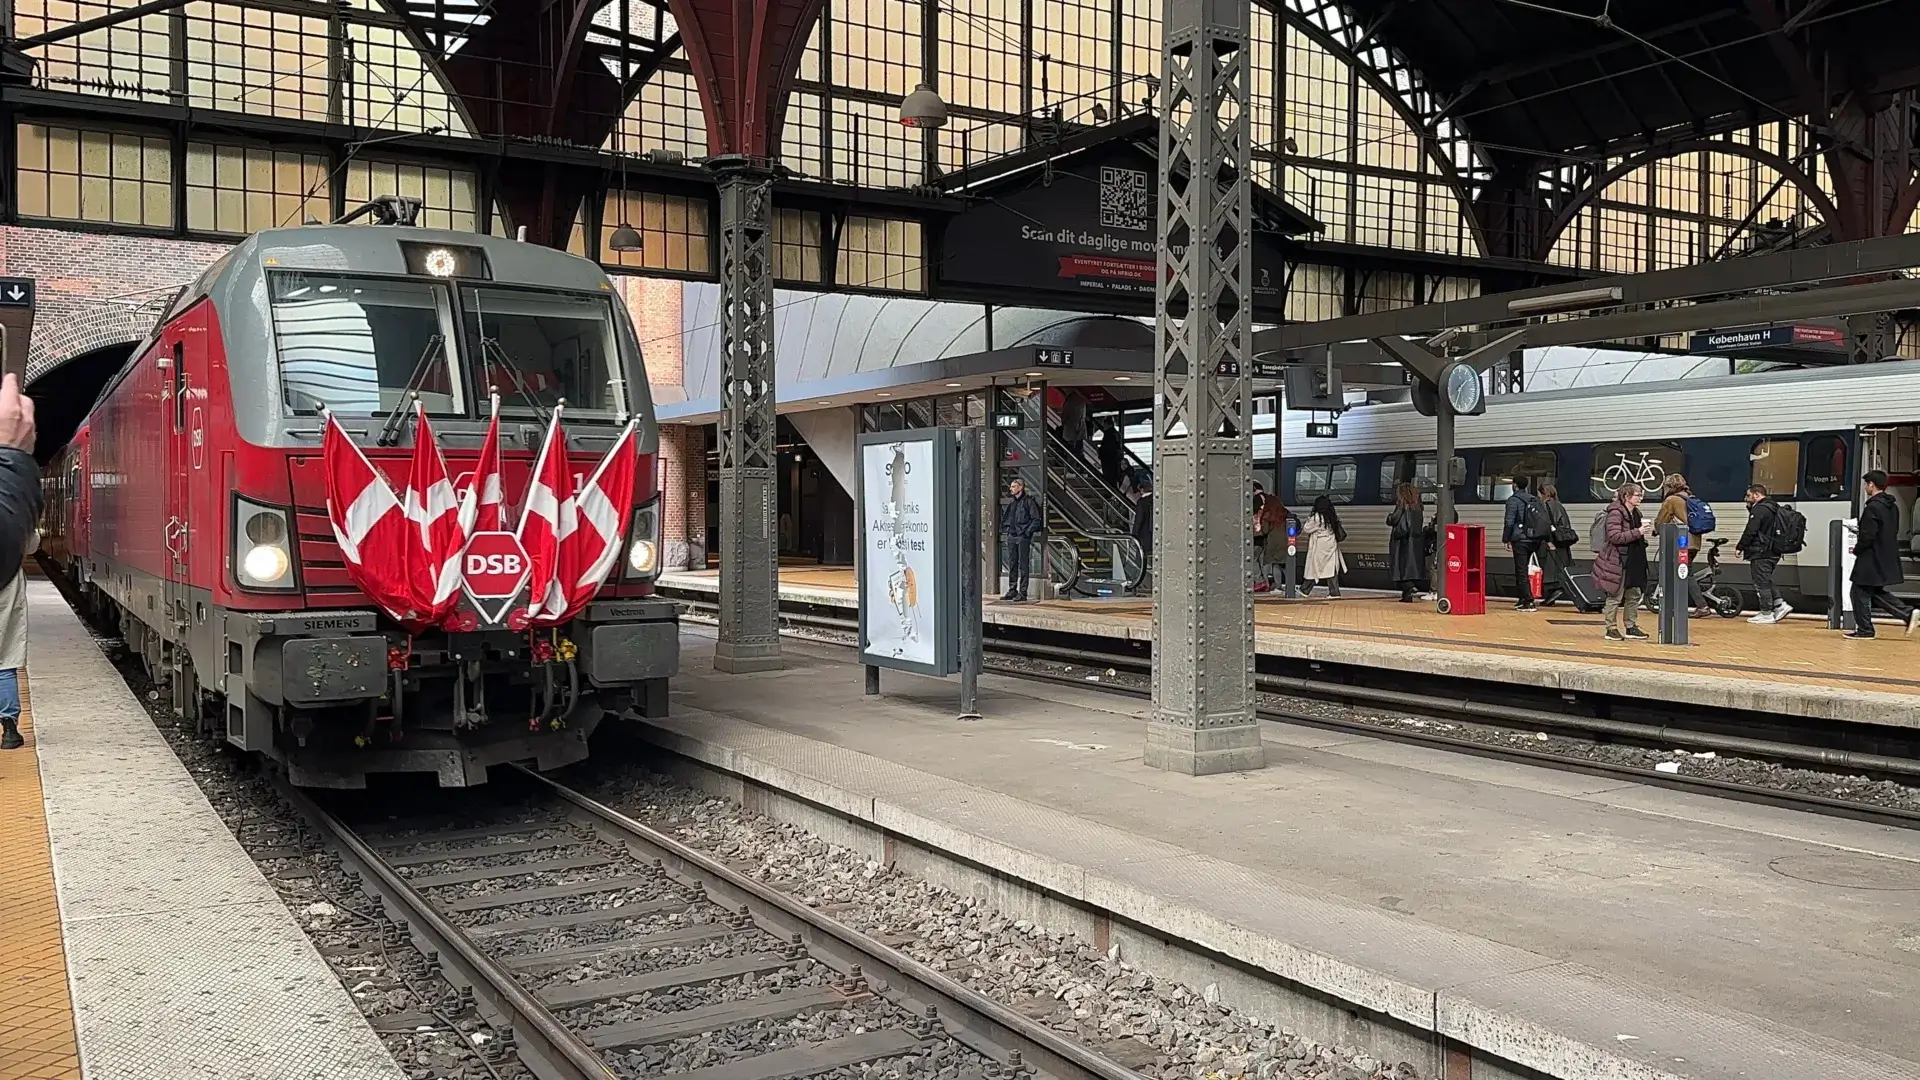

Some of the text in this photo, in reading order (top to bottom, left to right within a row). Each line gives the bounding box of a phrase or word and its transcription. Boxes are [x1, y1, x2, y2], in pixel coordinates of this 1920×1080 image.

[1021, 225, 1053, 242] Scan
[1057, 229, 1076, 245] dit
[1078, 231, 1128, 252] daglige
[1074, 258, 1103, 266] EVENTYRET
[1103, 261, 1136, 270] FORTSÆTTER
[1080, 280, 1104, 289] IMPERIAL
[1111, 283, 1132, 291] PALADS
[1708, 330, 1771, 345] København H
[877, 539, 887, 550] er
[910, 539, 925, 552] test
[467, 554, 521, 575] DSB
[609, 608, 645, 617] Vectron
[303, 618, 360, 630] SIEMENS
